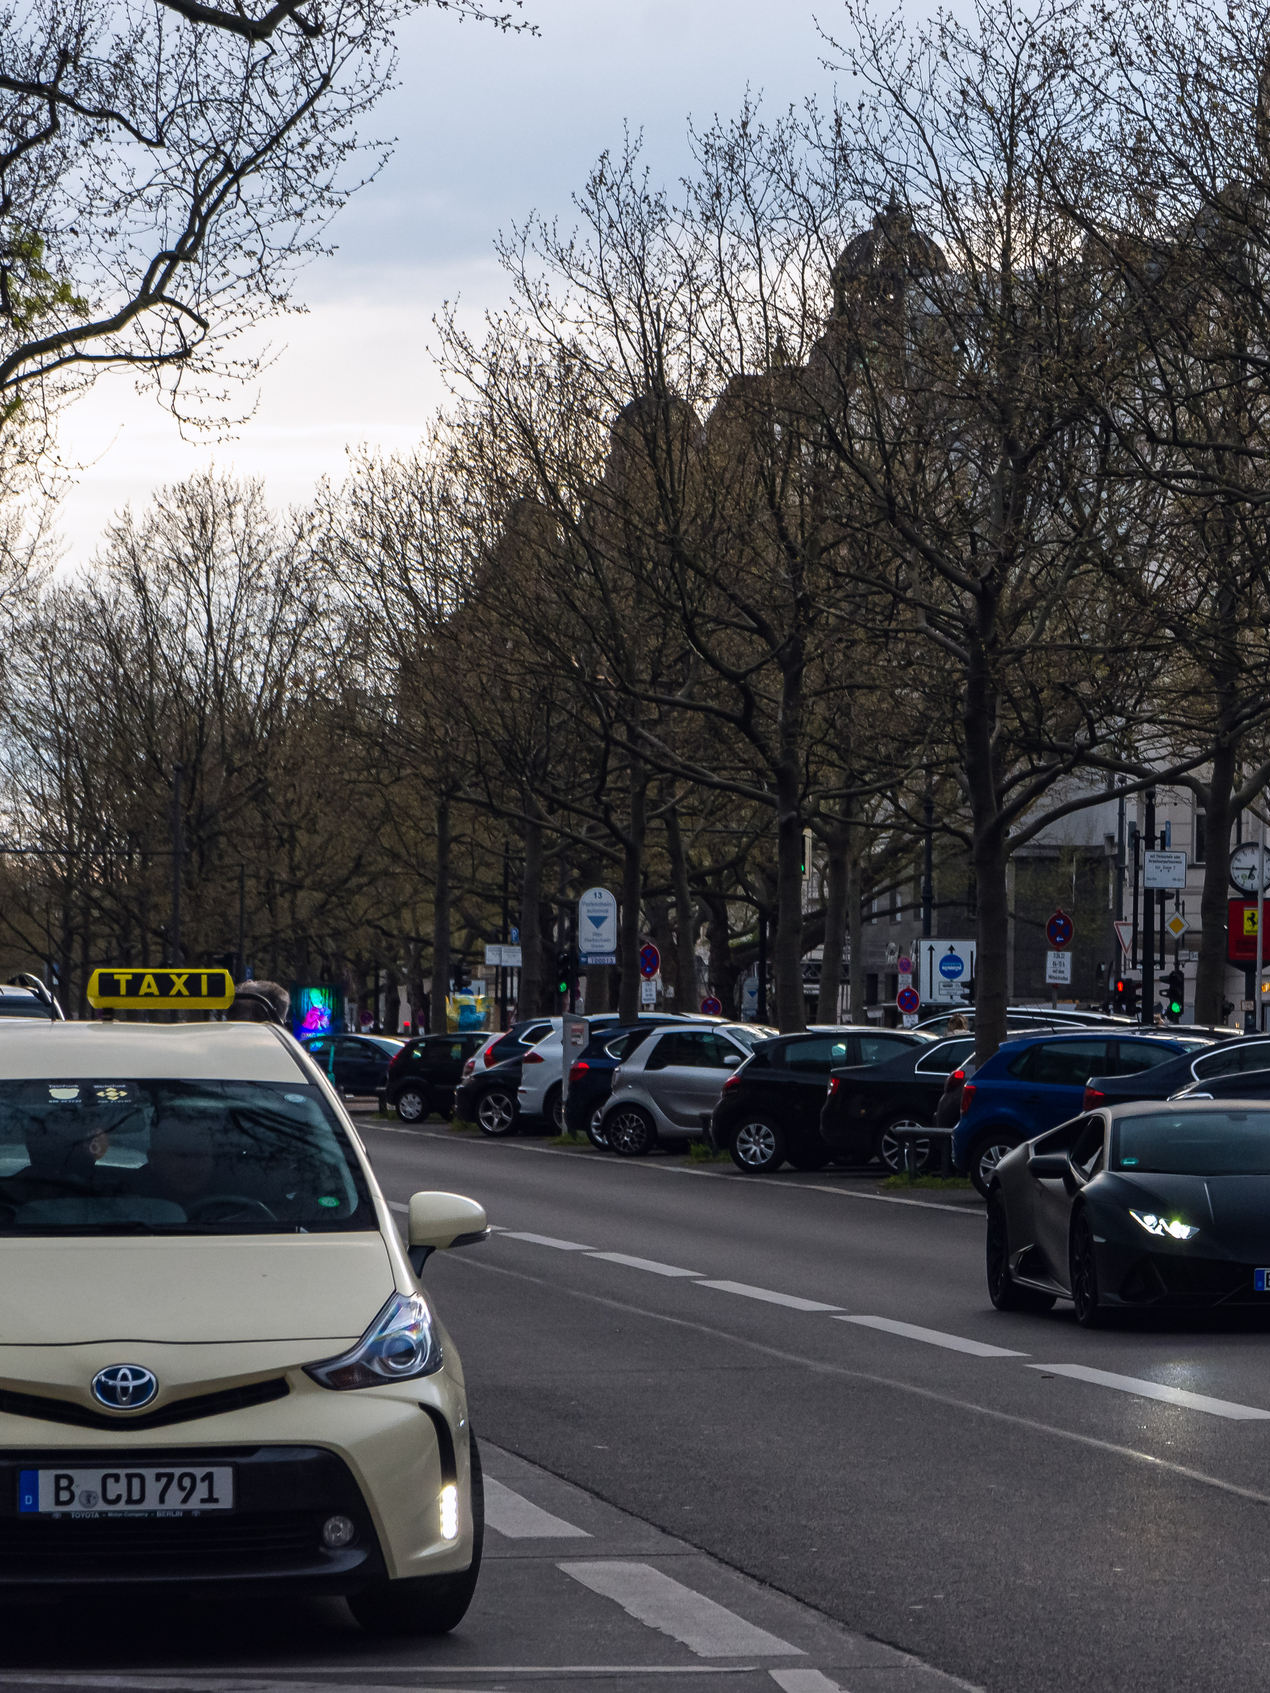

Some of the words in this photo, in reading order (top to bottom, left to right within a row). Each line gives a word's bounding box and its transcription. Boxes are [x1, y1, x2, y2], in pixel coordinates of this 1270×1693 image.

[594, 891, 603, 899] 13
[113, 974, 210, 996] TAXI
[54, 1474, 75, 1506] B
[101, 1473, 146, 1506] CD
[155, 1472, 219, 1504] 791
